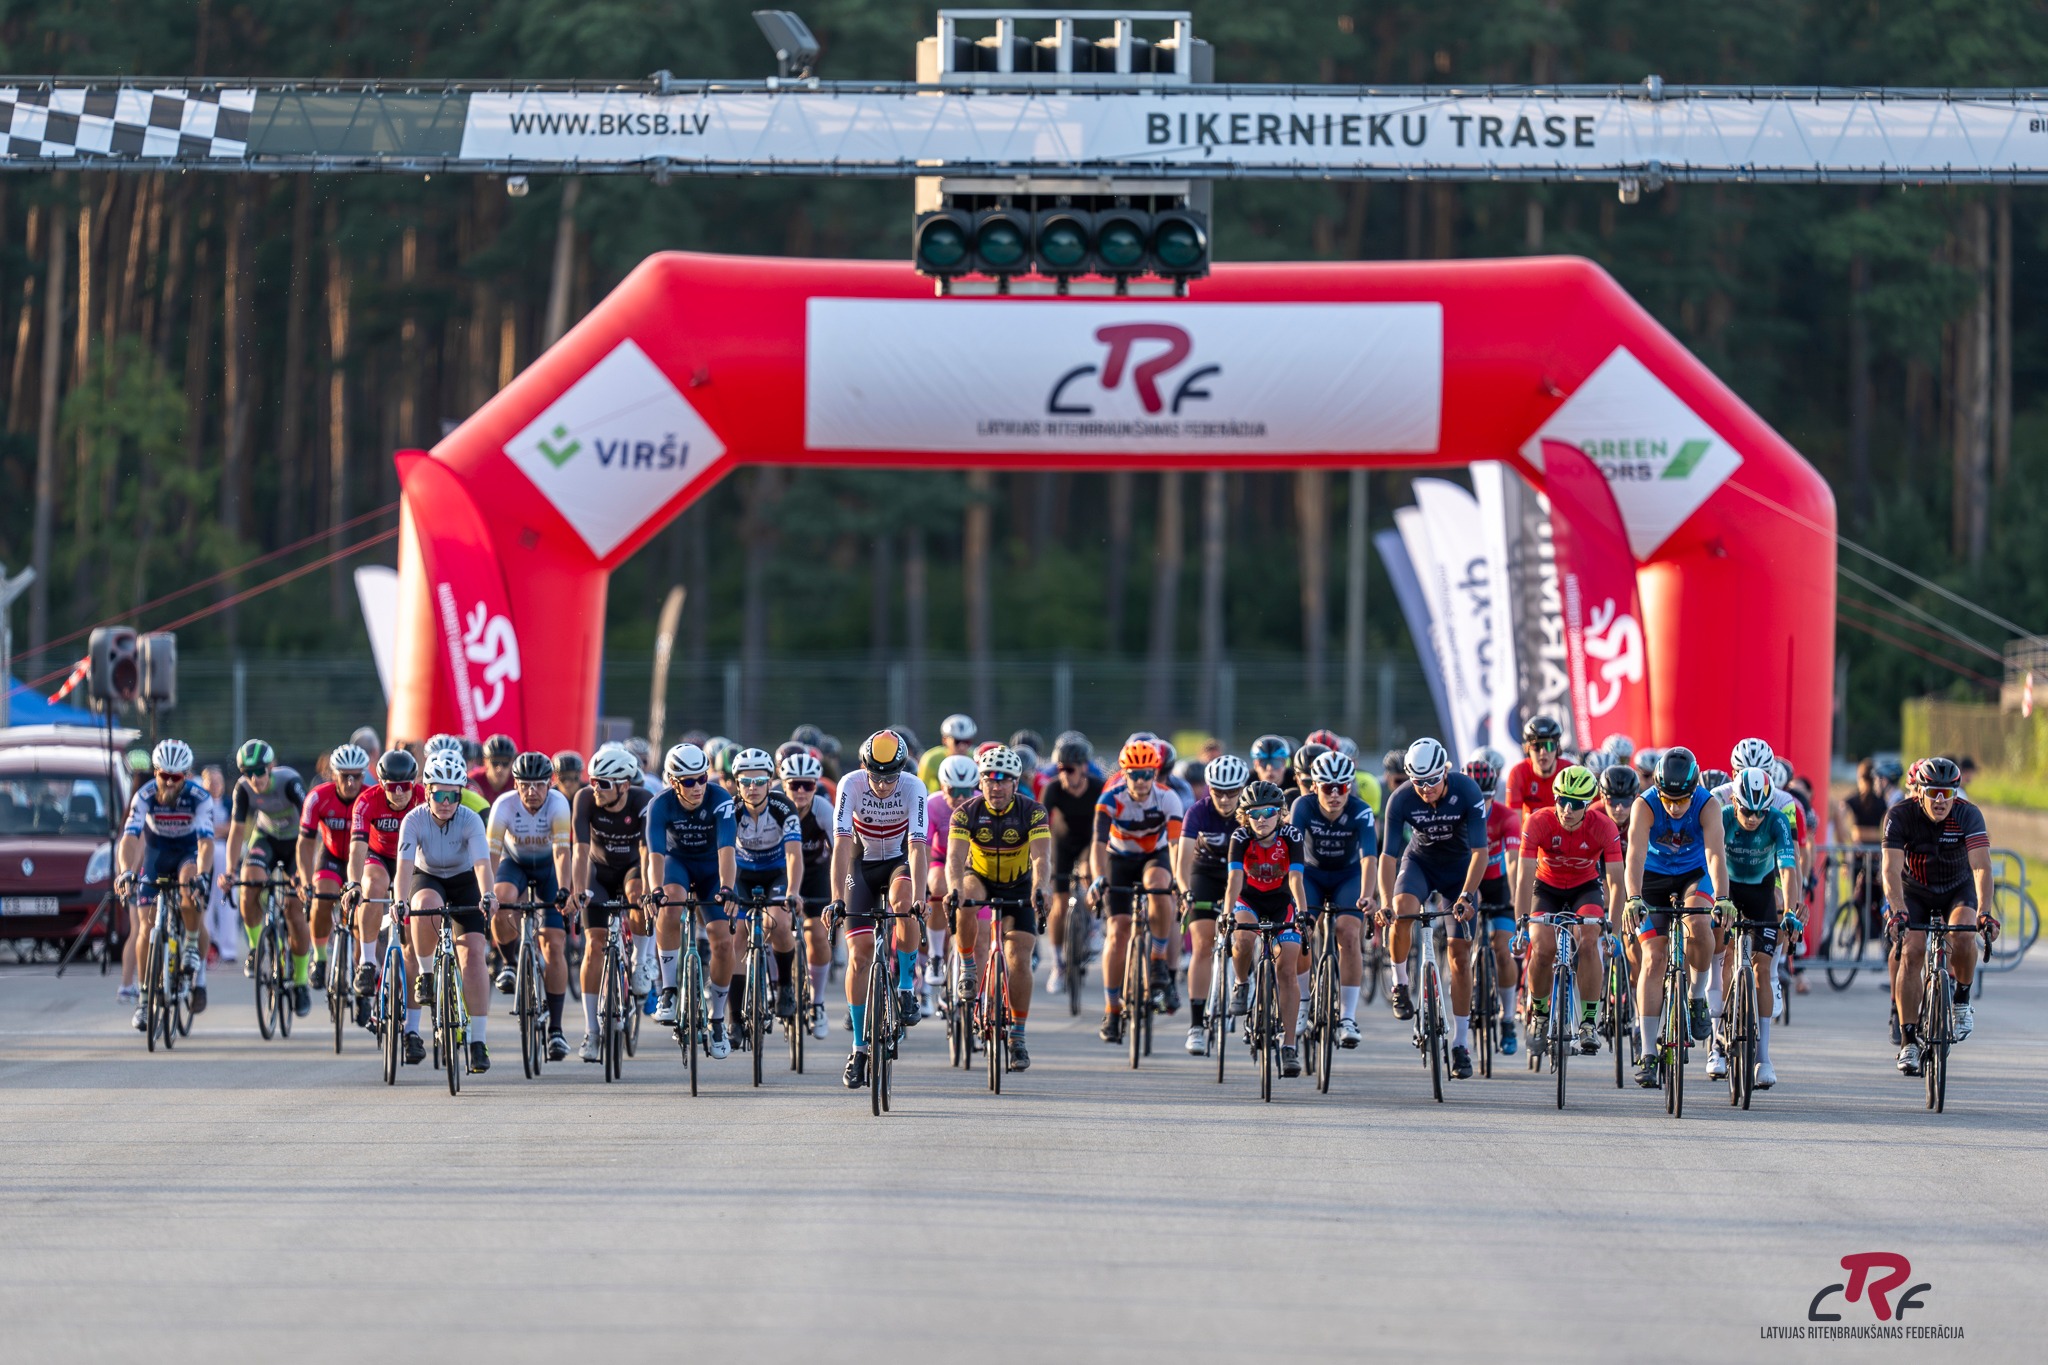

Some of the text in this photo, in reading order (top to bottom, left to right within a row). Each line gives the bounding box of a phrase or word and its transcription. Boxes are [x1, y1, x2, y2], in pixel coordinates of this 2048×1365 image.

[509, 112, 710, 136] WWW.BKSB.LV
[2029, 119, 2048, 133] BI
[1145, 112, 1596, 158] BIĶERNIEKU TRASE
[594, 431, 690, 470] VIRŠI
[1581, 438, 1668, 458] GREEN
[837, 791, 848, 822] MERIDA
[861, 798, 903, 810] CANNIBAL
[325, 817, 346, 830] VELO
[377, 818, 399, 830] VELO
[1412, 814, 1461, 824] Peloton
[1310, 825, 1353, 837] Peloton
